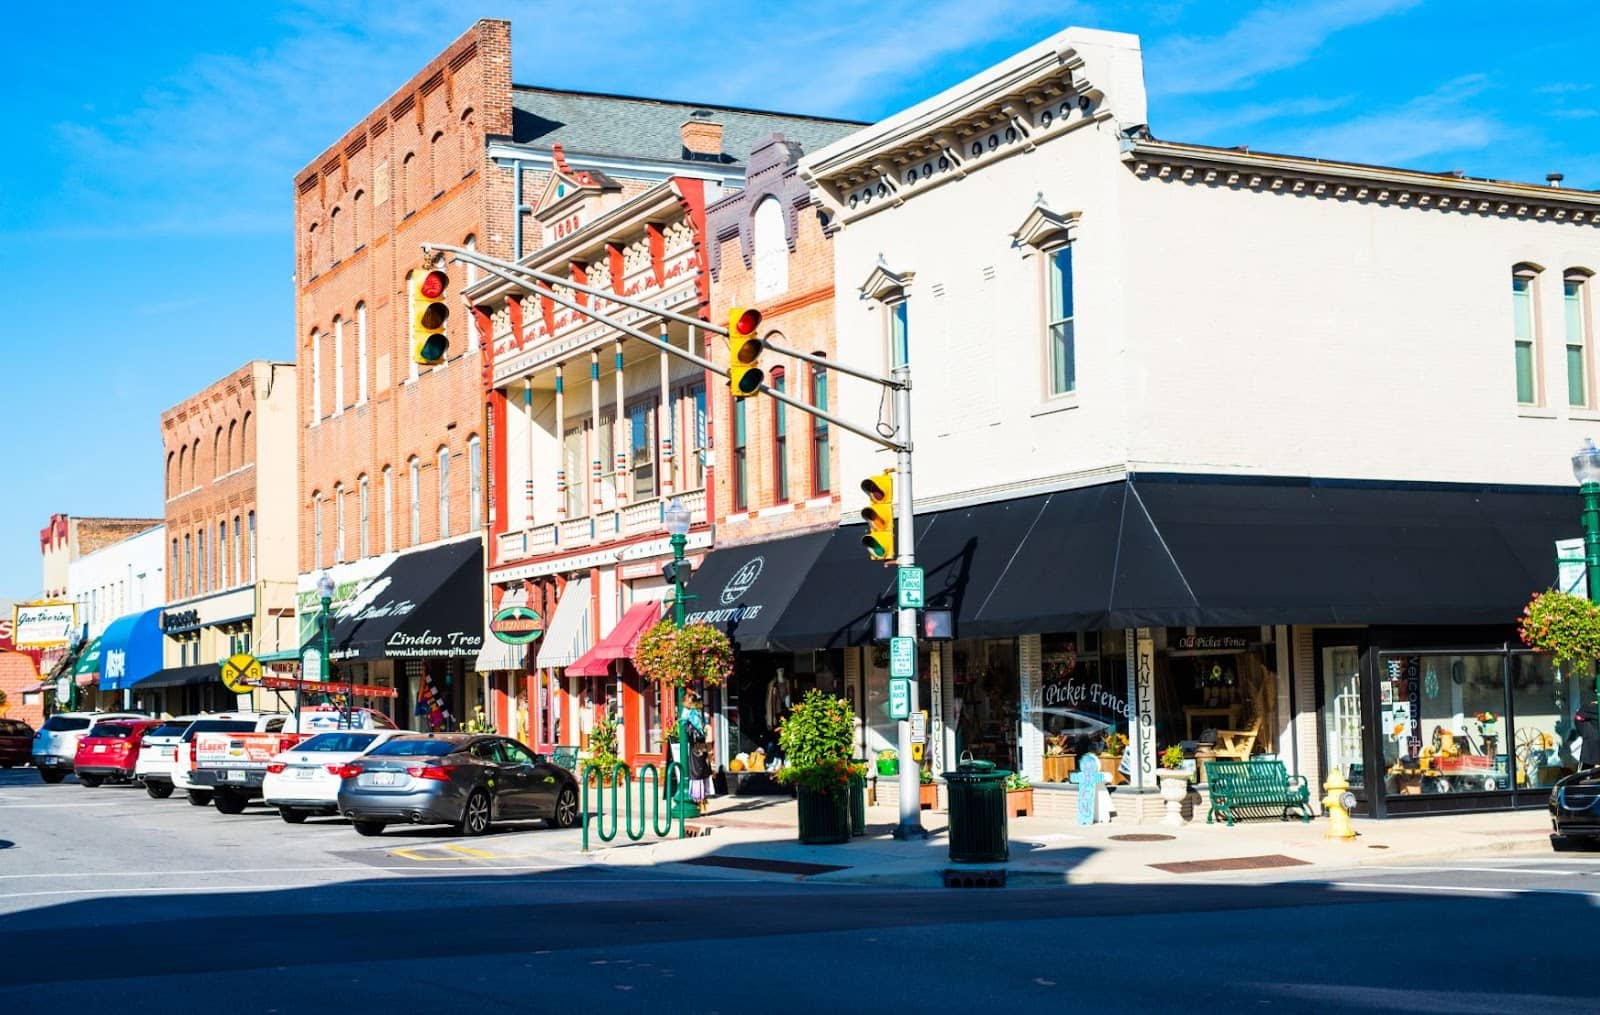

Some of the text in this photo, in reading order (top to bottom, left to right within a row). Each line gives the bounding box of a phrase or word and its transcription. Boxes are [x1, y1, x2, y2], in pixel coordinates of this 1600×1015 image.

[704, 605, 763, 623] BOUTIQUE
[386, 629, 480, 646] Linden Tree
[226, 668, 259, 679] R R
[1045, 677, 1088, 706] Picket
[1090, 683, 1131, 718] Fence
[933, 663, 943, 771] ANTIQUES
[1138, 653, 1153, 774] ANTIQUES
